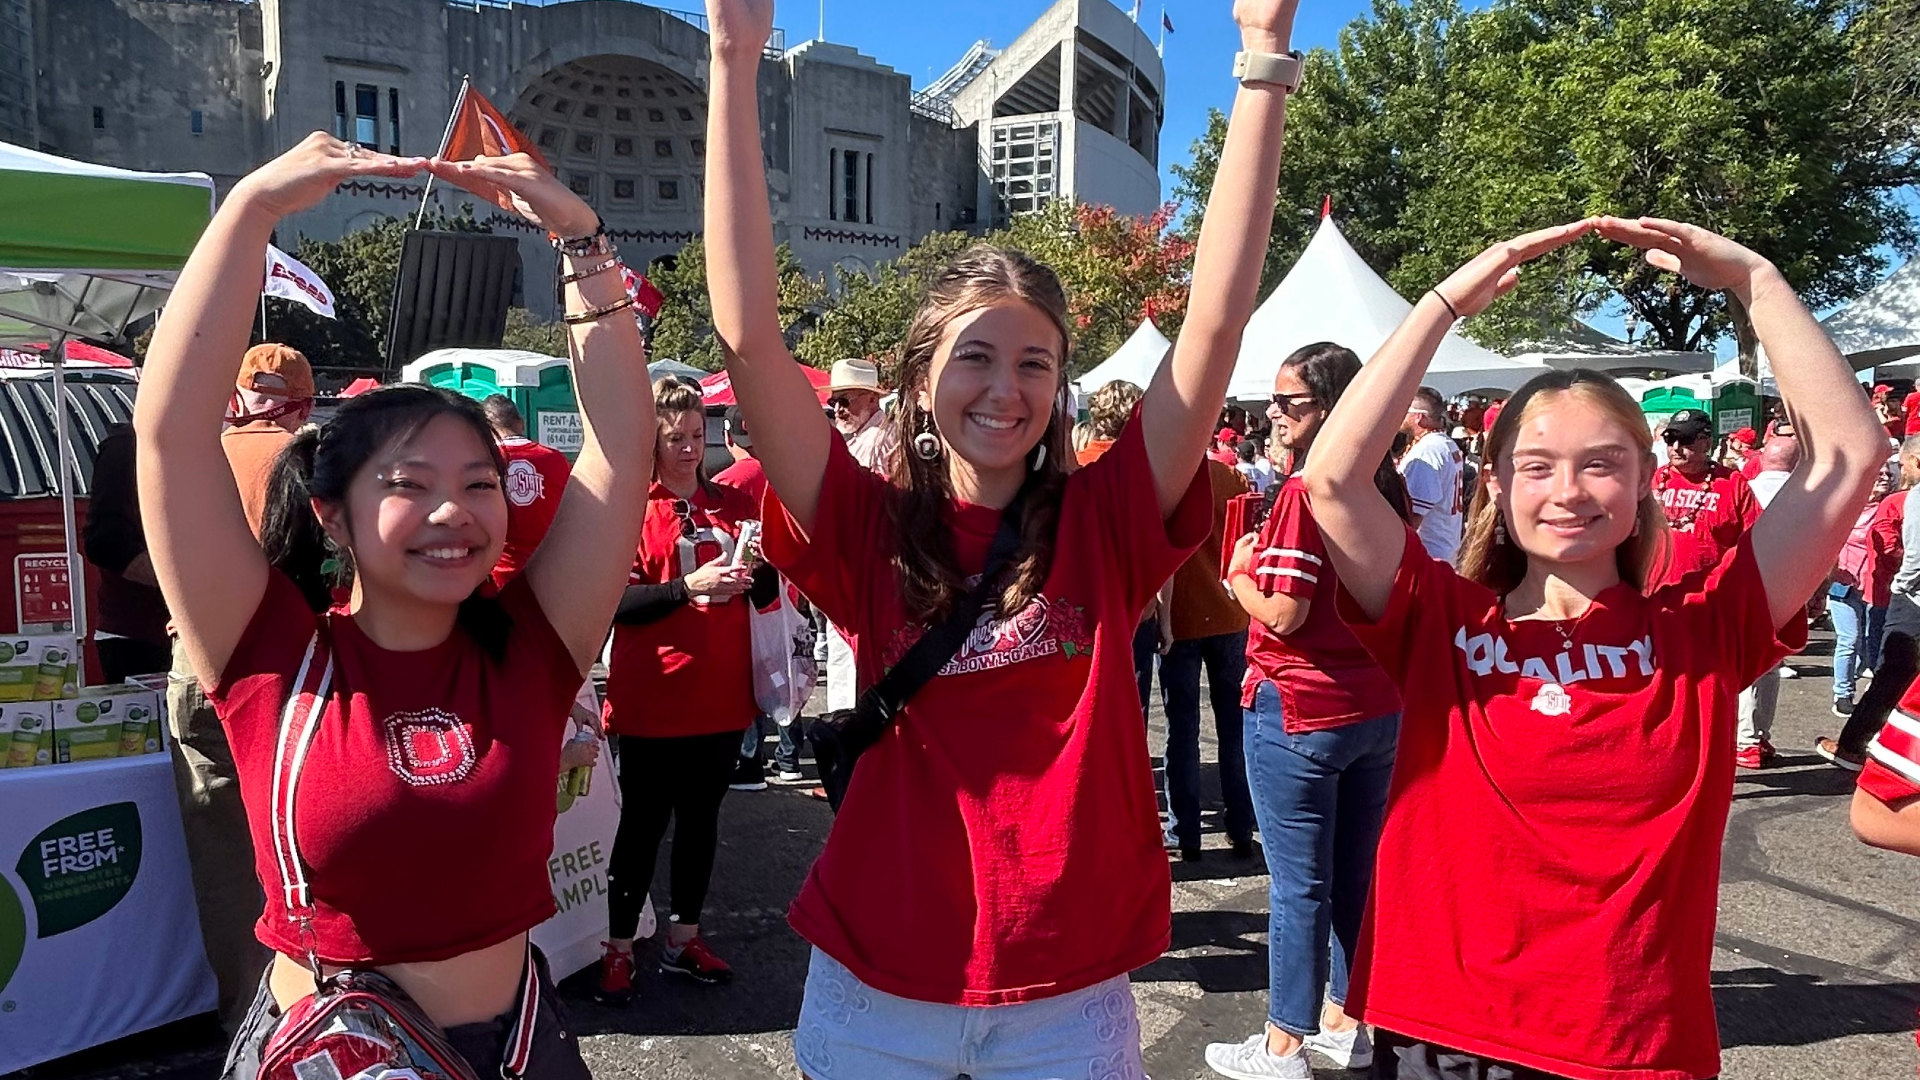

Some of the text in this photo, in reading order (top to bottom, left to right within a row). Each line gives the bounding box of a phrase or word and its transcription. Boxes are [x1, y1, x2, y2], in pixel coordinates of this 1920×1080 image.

[24, 559, 69, 568] RECYCL
[959, 652, 1008, 673] BOWL
[1011, 638, 1058, 663] GAME
[1454, 625, 1657, 685] QUALITY
[40, 828, 115, 859] FREE
[548, 841, 604, 884] FREE
